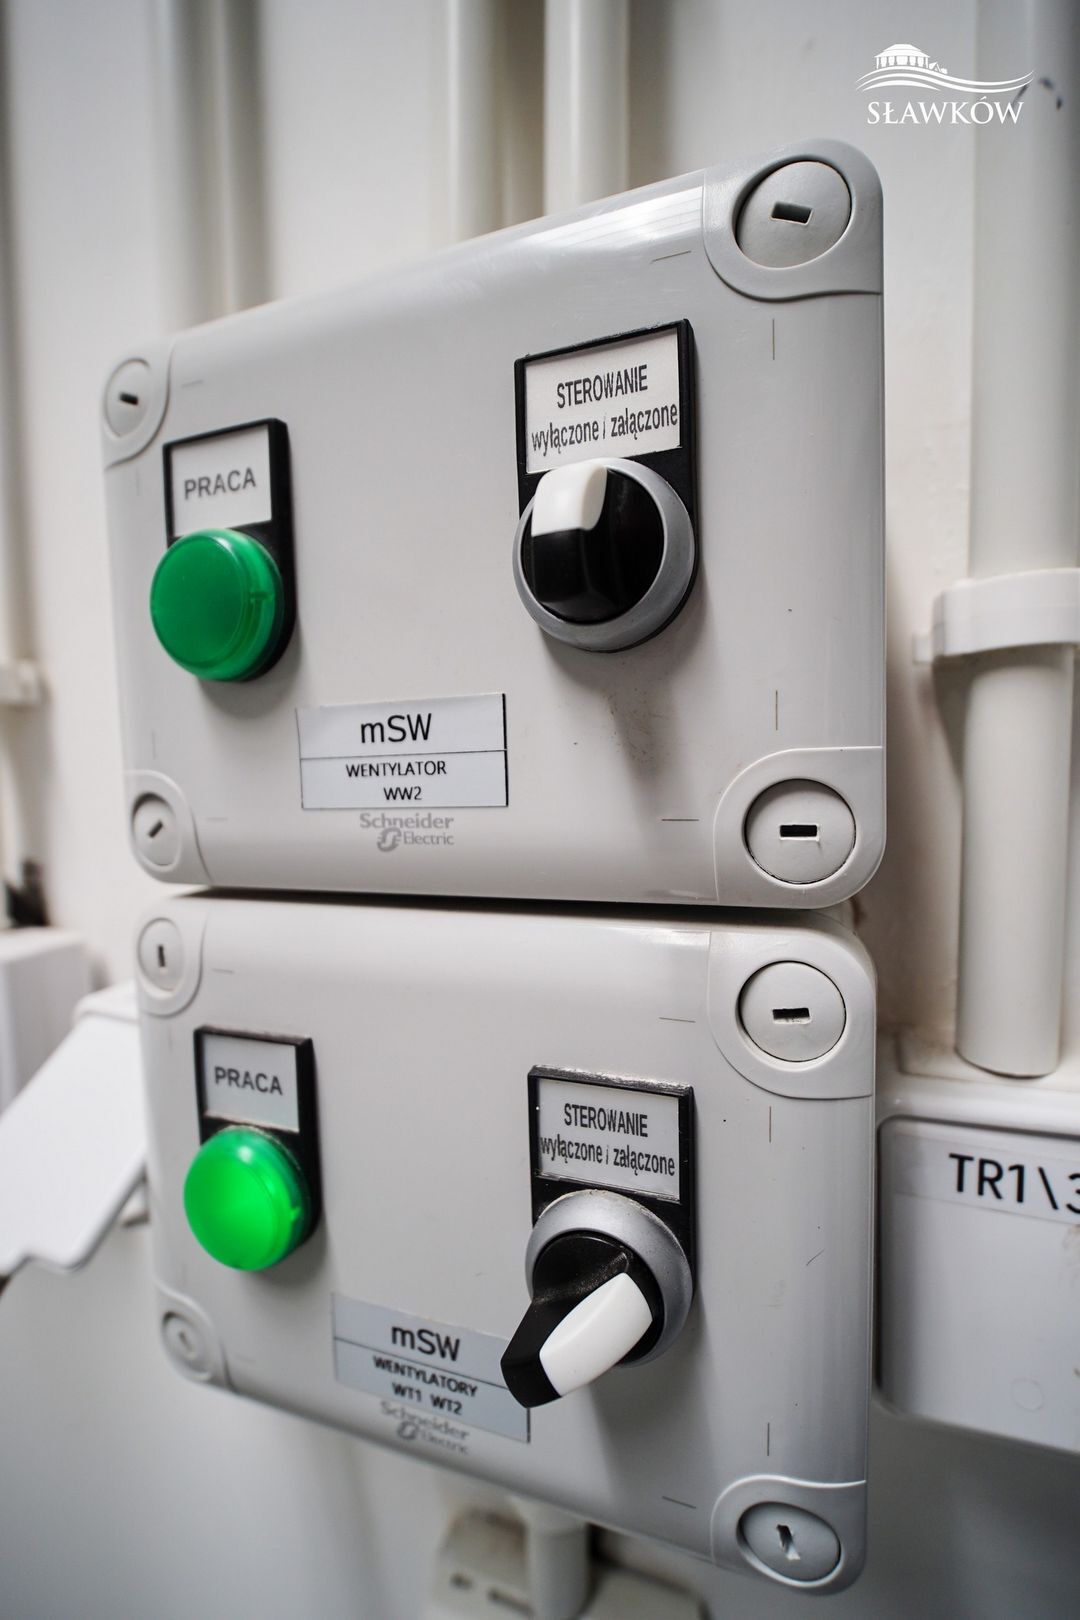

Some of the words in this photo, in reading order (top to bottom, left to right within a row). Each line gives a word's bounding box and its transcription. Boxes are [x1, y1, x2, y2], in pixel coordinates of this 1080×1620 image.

[556, 364, 648, 409] STEROWANIE
[531, 420, 599, 457] wyłączone
[610, 403, 678, 440] załączone
[184, 466, 257, 500] PRACA
[360, 713, 432, 744] mSW
[345, 760, 447, 778] WENTYLATOR
[383, 786, 422, 801] WW2
[359, 812, 455, 829] Schneider
[403, 831, 455, 846] Electric
[214, 1065, 283, 1096] PRACA
[564, 1103, 649, 1138] STEROWANIE
[540, 1133, 603, 1164] wyłączone
[613, 1144, 676, 1176] załączone
[391, 1326, 460, 1362] mSW
[372, 1355, 478, 1398] WENTYLATORY
[392, 1382, 422, 1402] WT1
[430, 1394, 463, 1416] WT2
